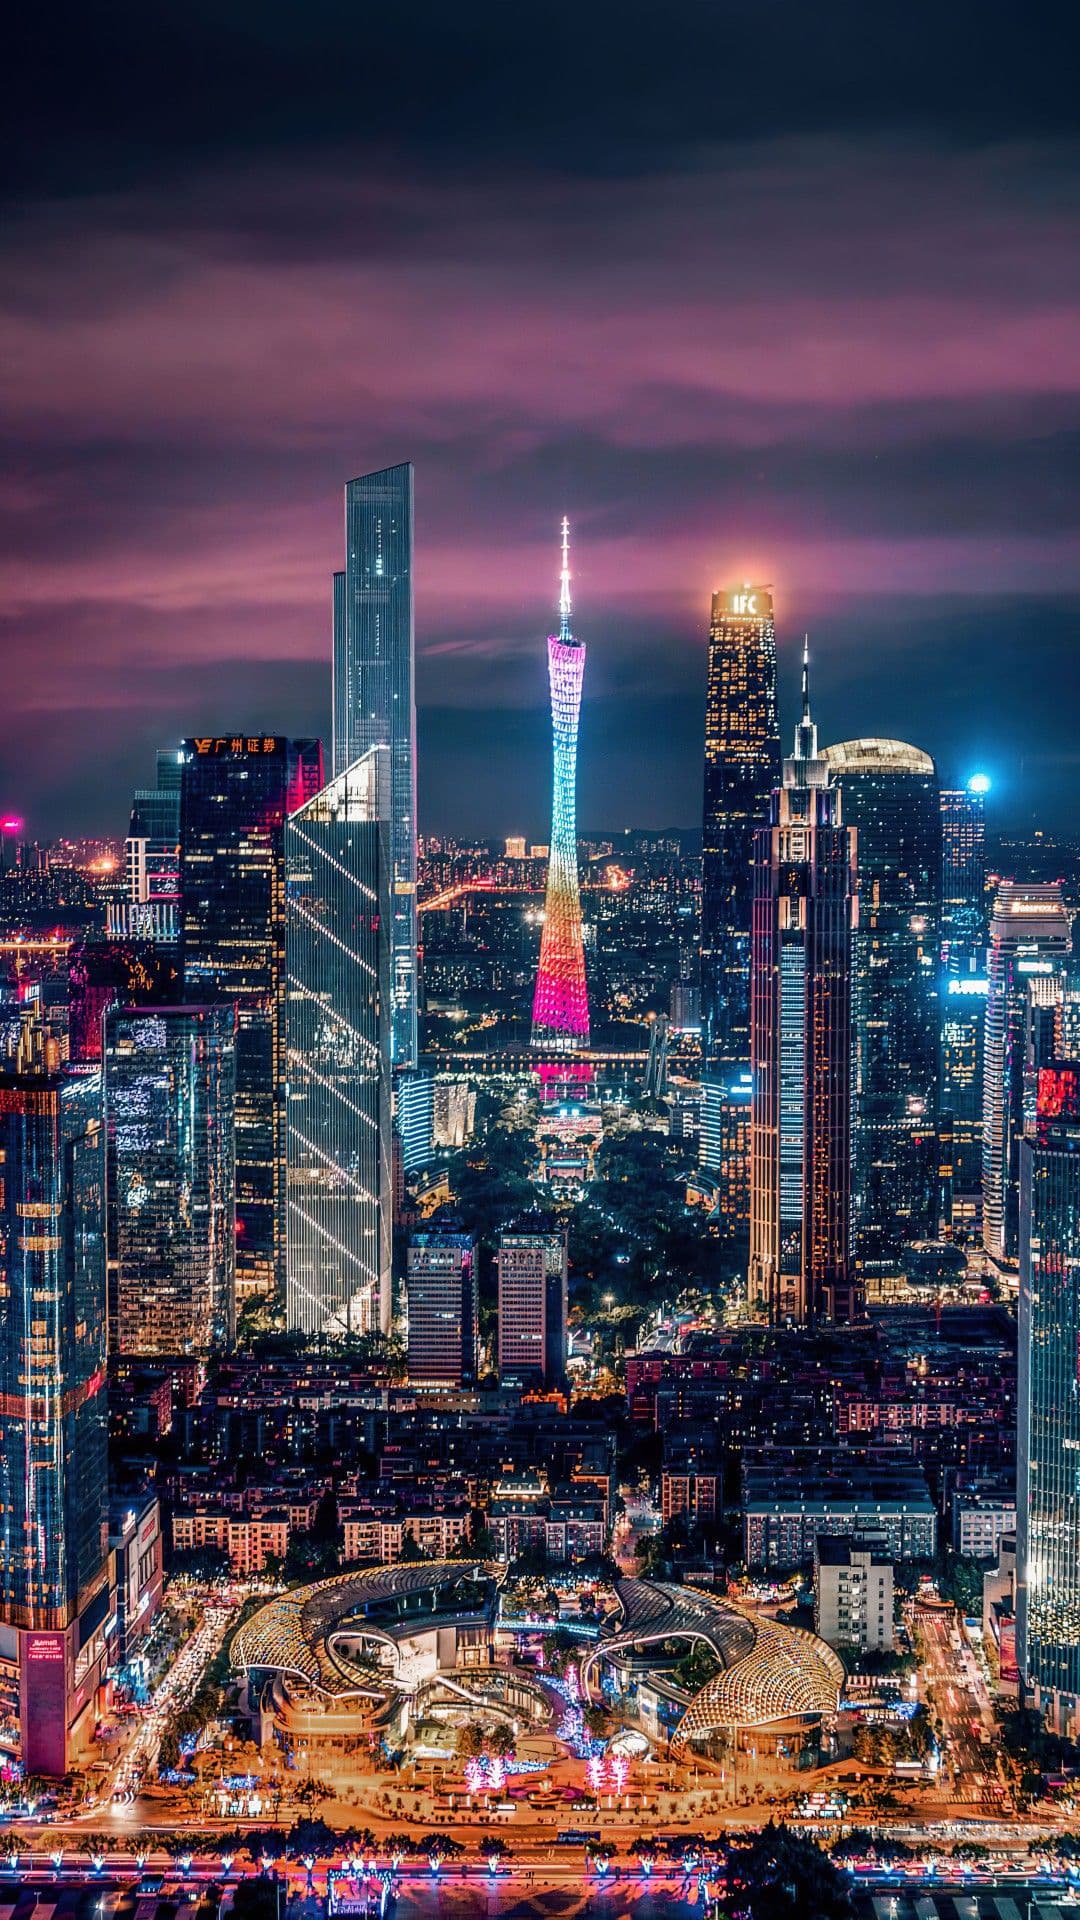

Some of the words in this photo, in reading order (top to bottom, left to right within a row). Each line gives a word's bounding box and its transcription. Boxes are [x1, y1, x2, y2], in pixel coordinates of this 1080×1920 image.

[733, 595, 757, 614] IFC
[215, 738, 275, 753] 广州证券
